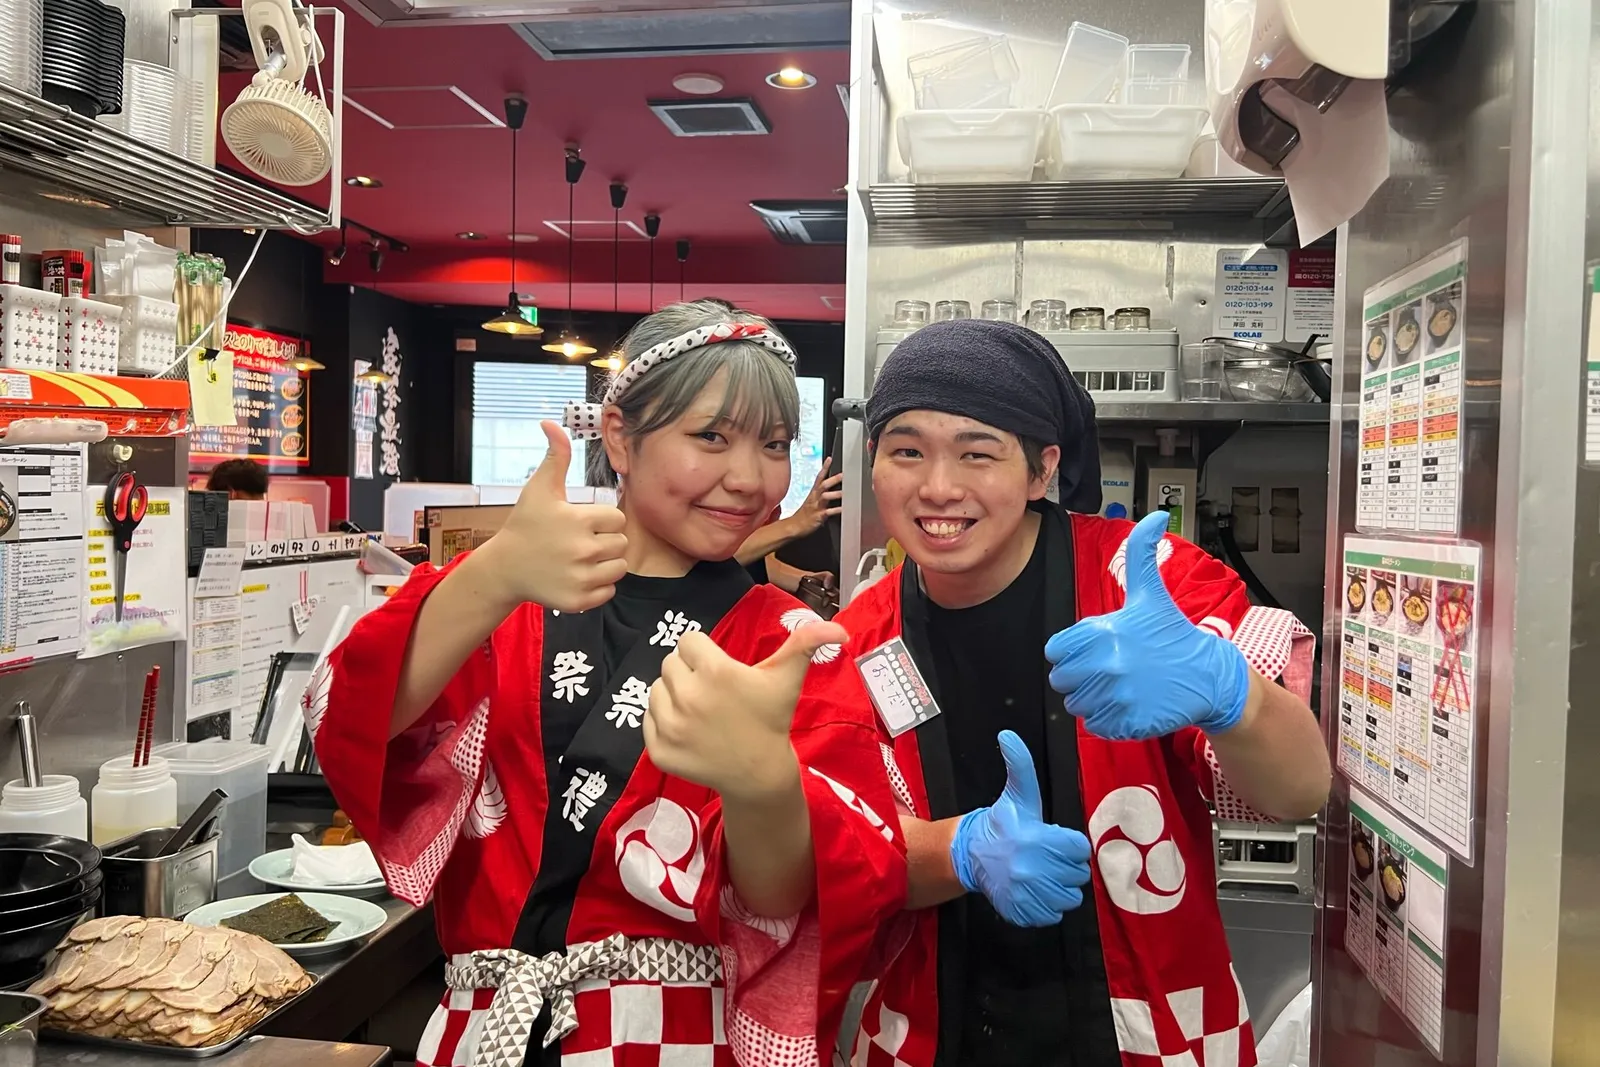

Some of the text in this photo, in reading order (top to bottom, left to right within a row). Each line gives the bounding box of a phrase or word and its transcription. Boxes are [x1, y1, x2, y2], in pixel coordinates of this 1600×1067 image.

[270, 541, 286, 555] のり
[549, 650, 595, 704] 祭
[872, 663, 906, 706] おさだ
